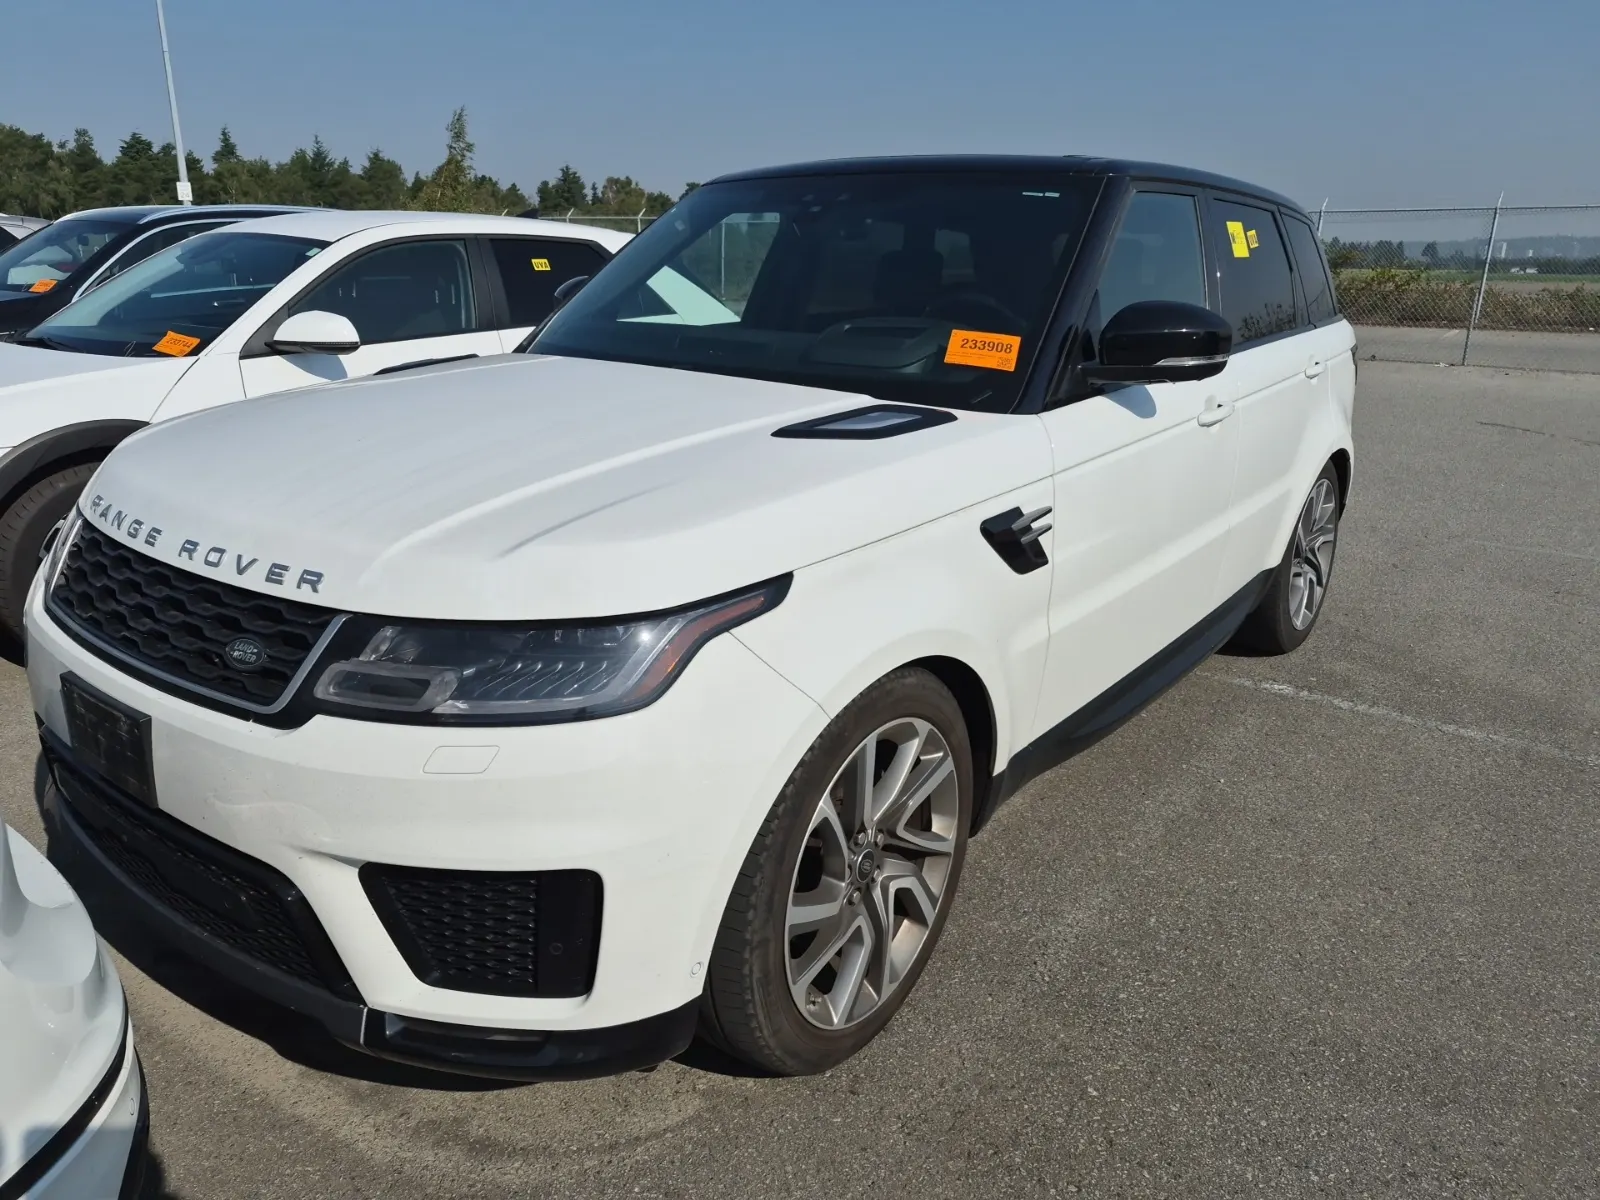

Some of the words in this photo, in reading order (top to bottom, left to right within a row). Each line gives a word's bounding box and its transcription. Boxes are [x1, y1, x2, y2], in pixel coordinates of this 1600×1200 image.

[533, 261, 549, 269] UVA
[960, 338, 1013, 354] 233908
[90, 494, 163, 547] RANGE
[178, 539, 324, 593] ROVER
[234, 641, 254, 653] LAND
[232, 650, 257, 663] ROVER
